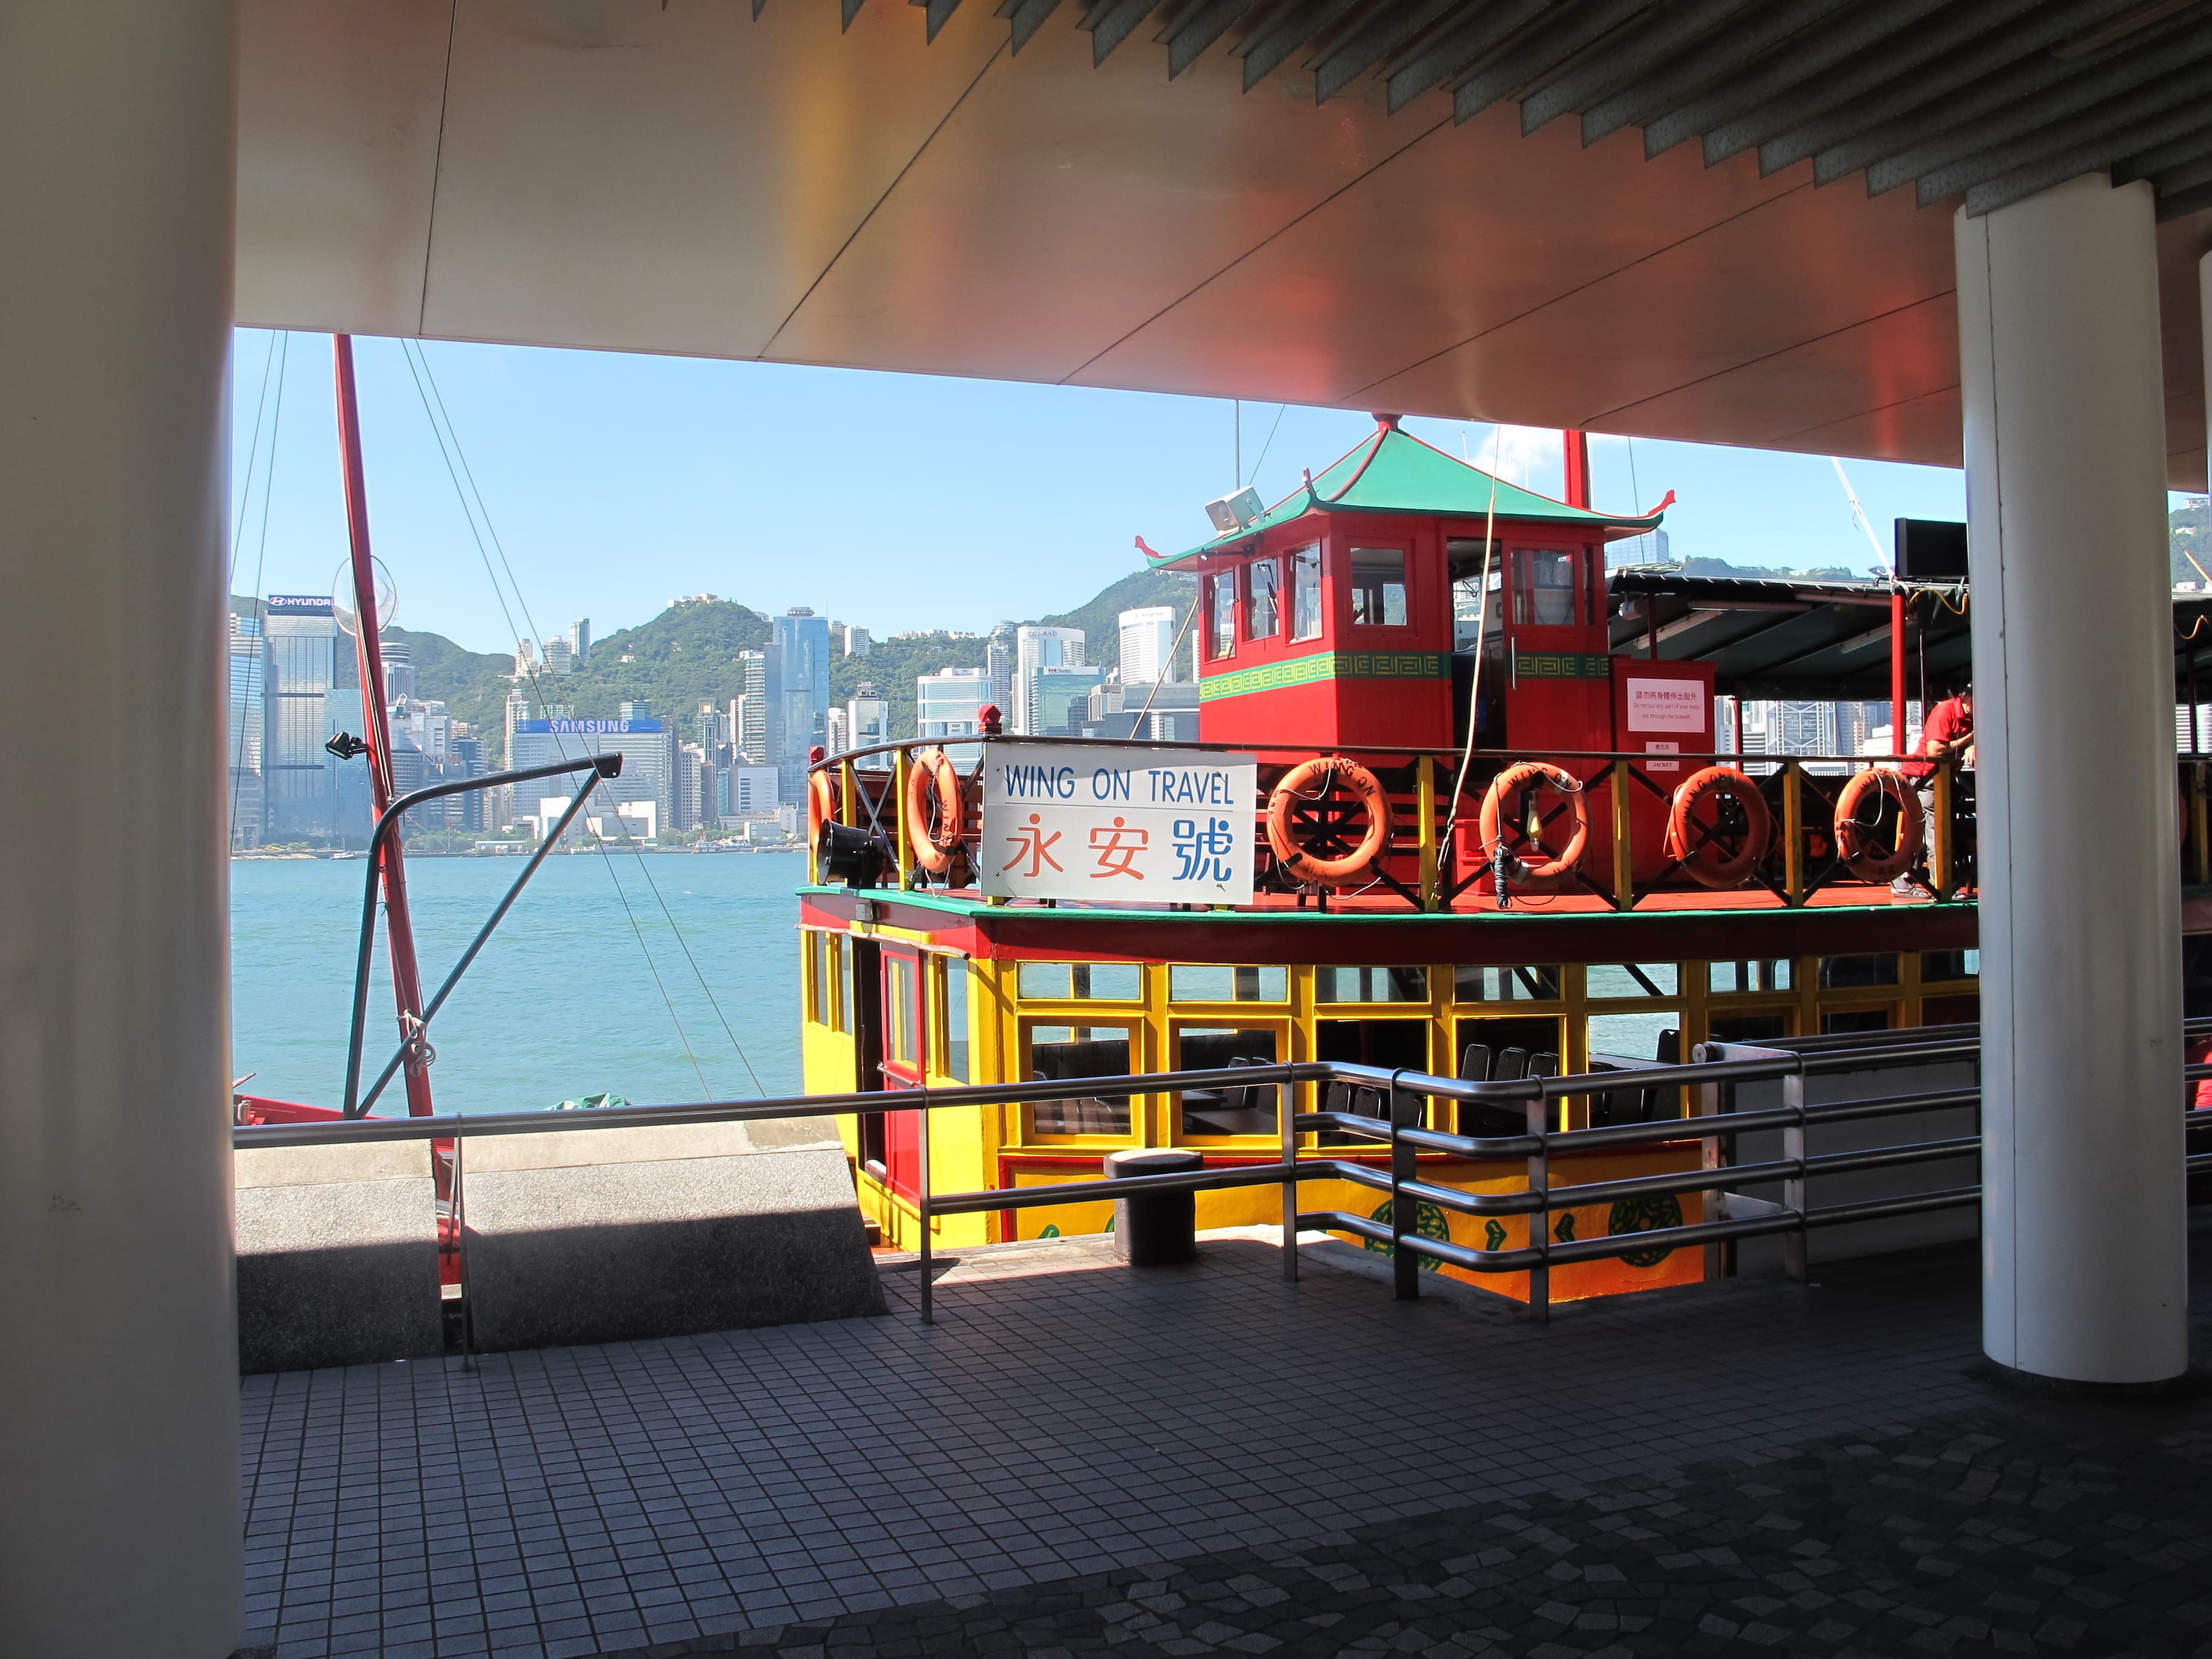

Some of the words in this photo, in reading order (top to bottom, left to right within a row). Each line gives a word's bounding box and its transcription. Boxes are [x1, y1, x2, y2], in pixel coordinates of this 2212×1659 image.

[287, 597, 333, 606] HYUNDAI
[550, 720, 629, 733] SAMSUNG
[421, 753, 444, 764] ING
[1005, 764, 1075, 799] WING
[1092, 768, 1131, 801] ON
[1148, 770, 1234, 805] TRAVEL
[1309, 762, 1355, 777] WING
[1358, 776, 1376, 797] ON
[1002, 813, 1234, 882] 永安號
